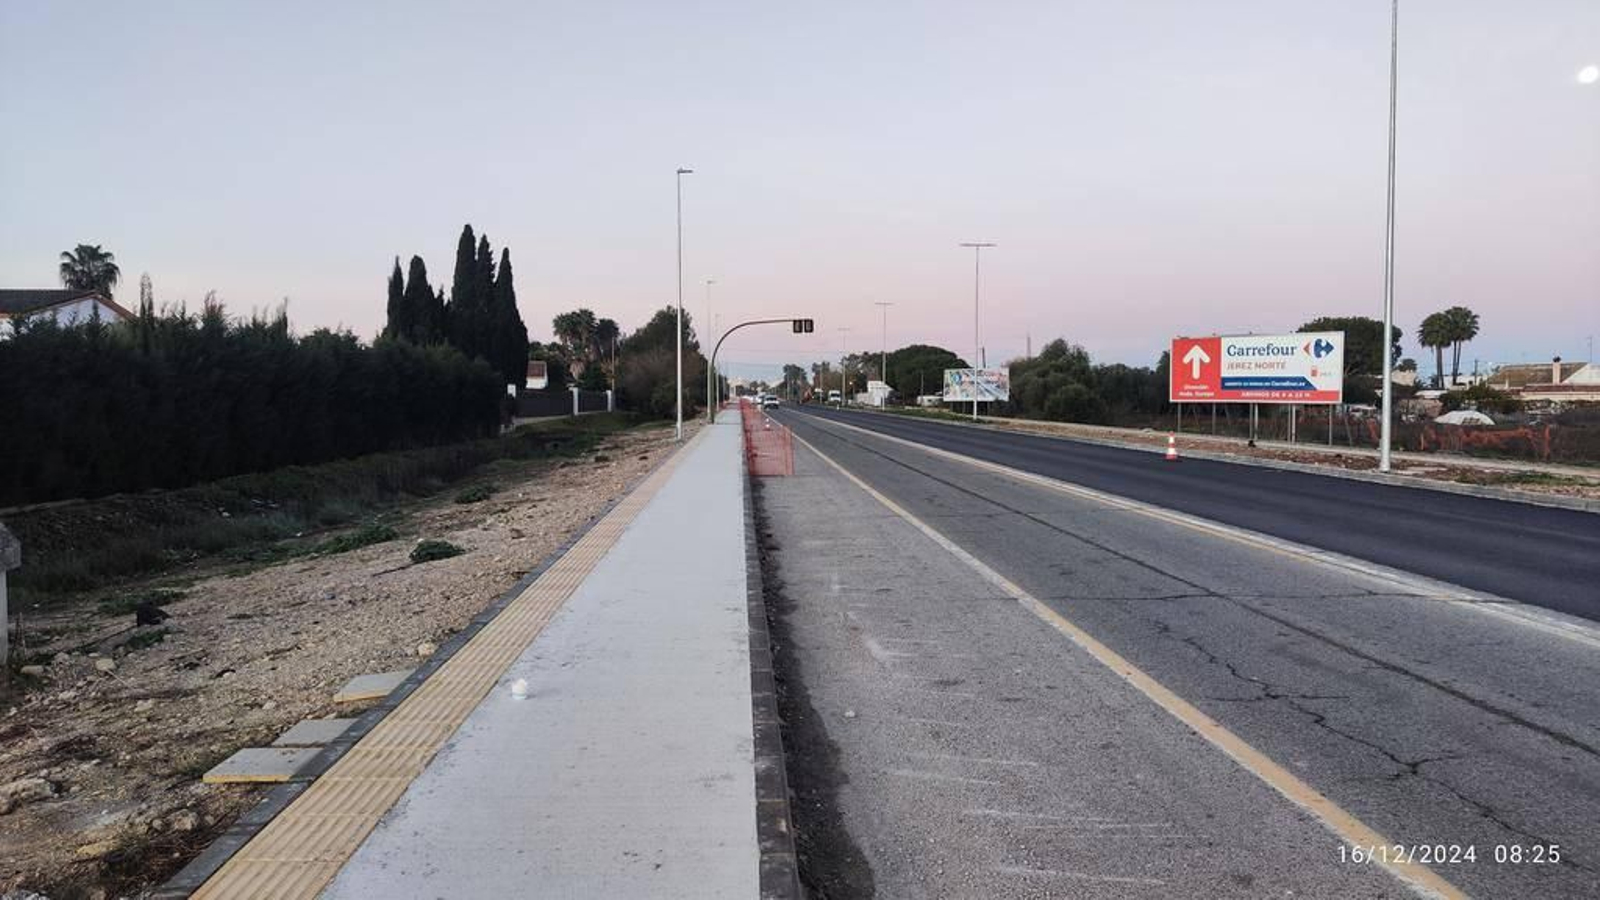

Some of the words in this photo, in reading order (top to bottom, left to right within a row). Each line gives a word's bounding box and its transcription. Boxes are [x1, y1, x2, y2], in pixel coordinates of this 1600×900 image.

[1227, 343, 1297, 357] Carrefour
[1227, 362, 1252, 370] JEREZ
[1255, 361, 1286, 369] NORTE
